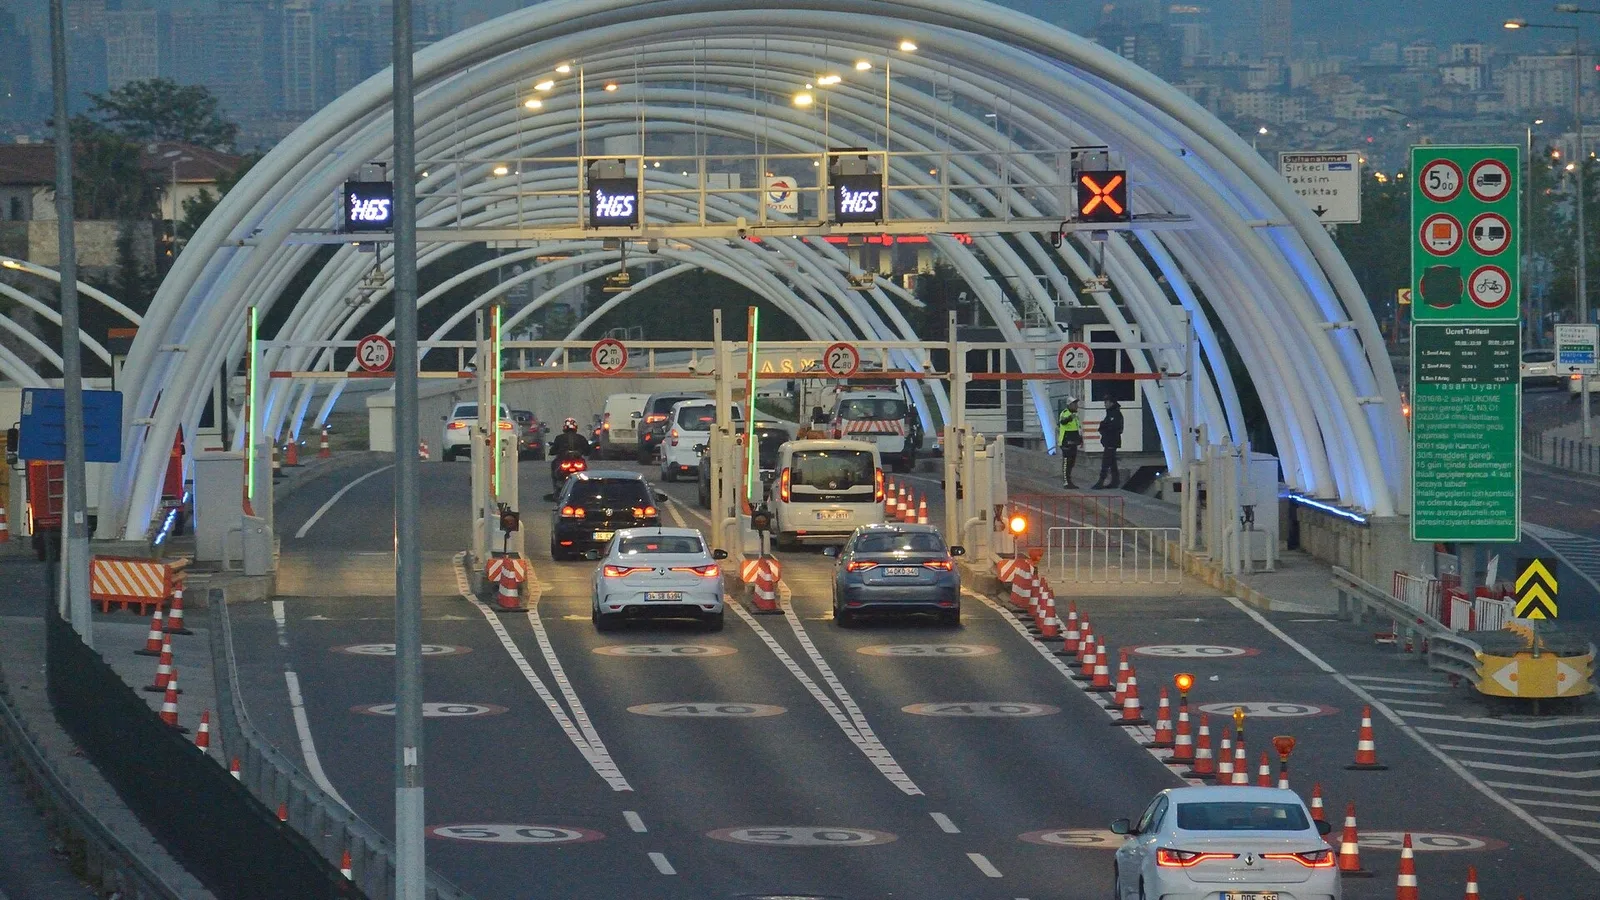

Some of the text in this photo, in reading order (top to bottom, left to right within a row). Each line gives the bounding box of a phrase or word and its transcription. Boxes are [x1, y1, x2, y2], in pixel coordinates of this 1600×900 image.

[1430, 171, 1440, 190] 5
[597, 195, 634, 216] HGS
[841, 191, 878, 212] HGS
[350, 199, 390, 220] HGS
[365, 345, 374, 361] 2
[599, 349, 608, 364] 2
[832, 353, 841, 368] 2
[1066, 352, 1075, 368] 2
[660, 705, 756, 714] 40
[935, 705, 1031, 714] 40
[448, 828, 568, 838] 50
[746, 830, 862, 841] 50
